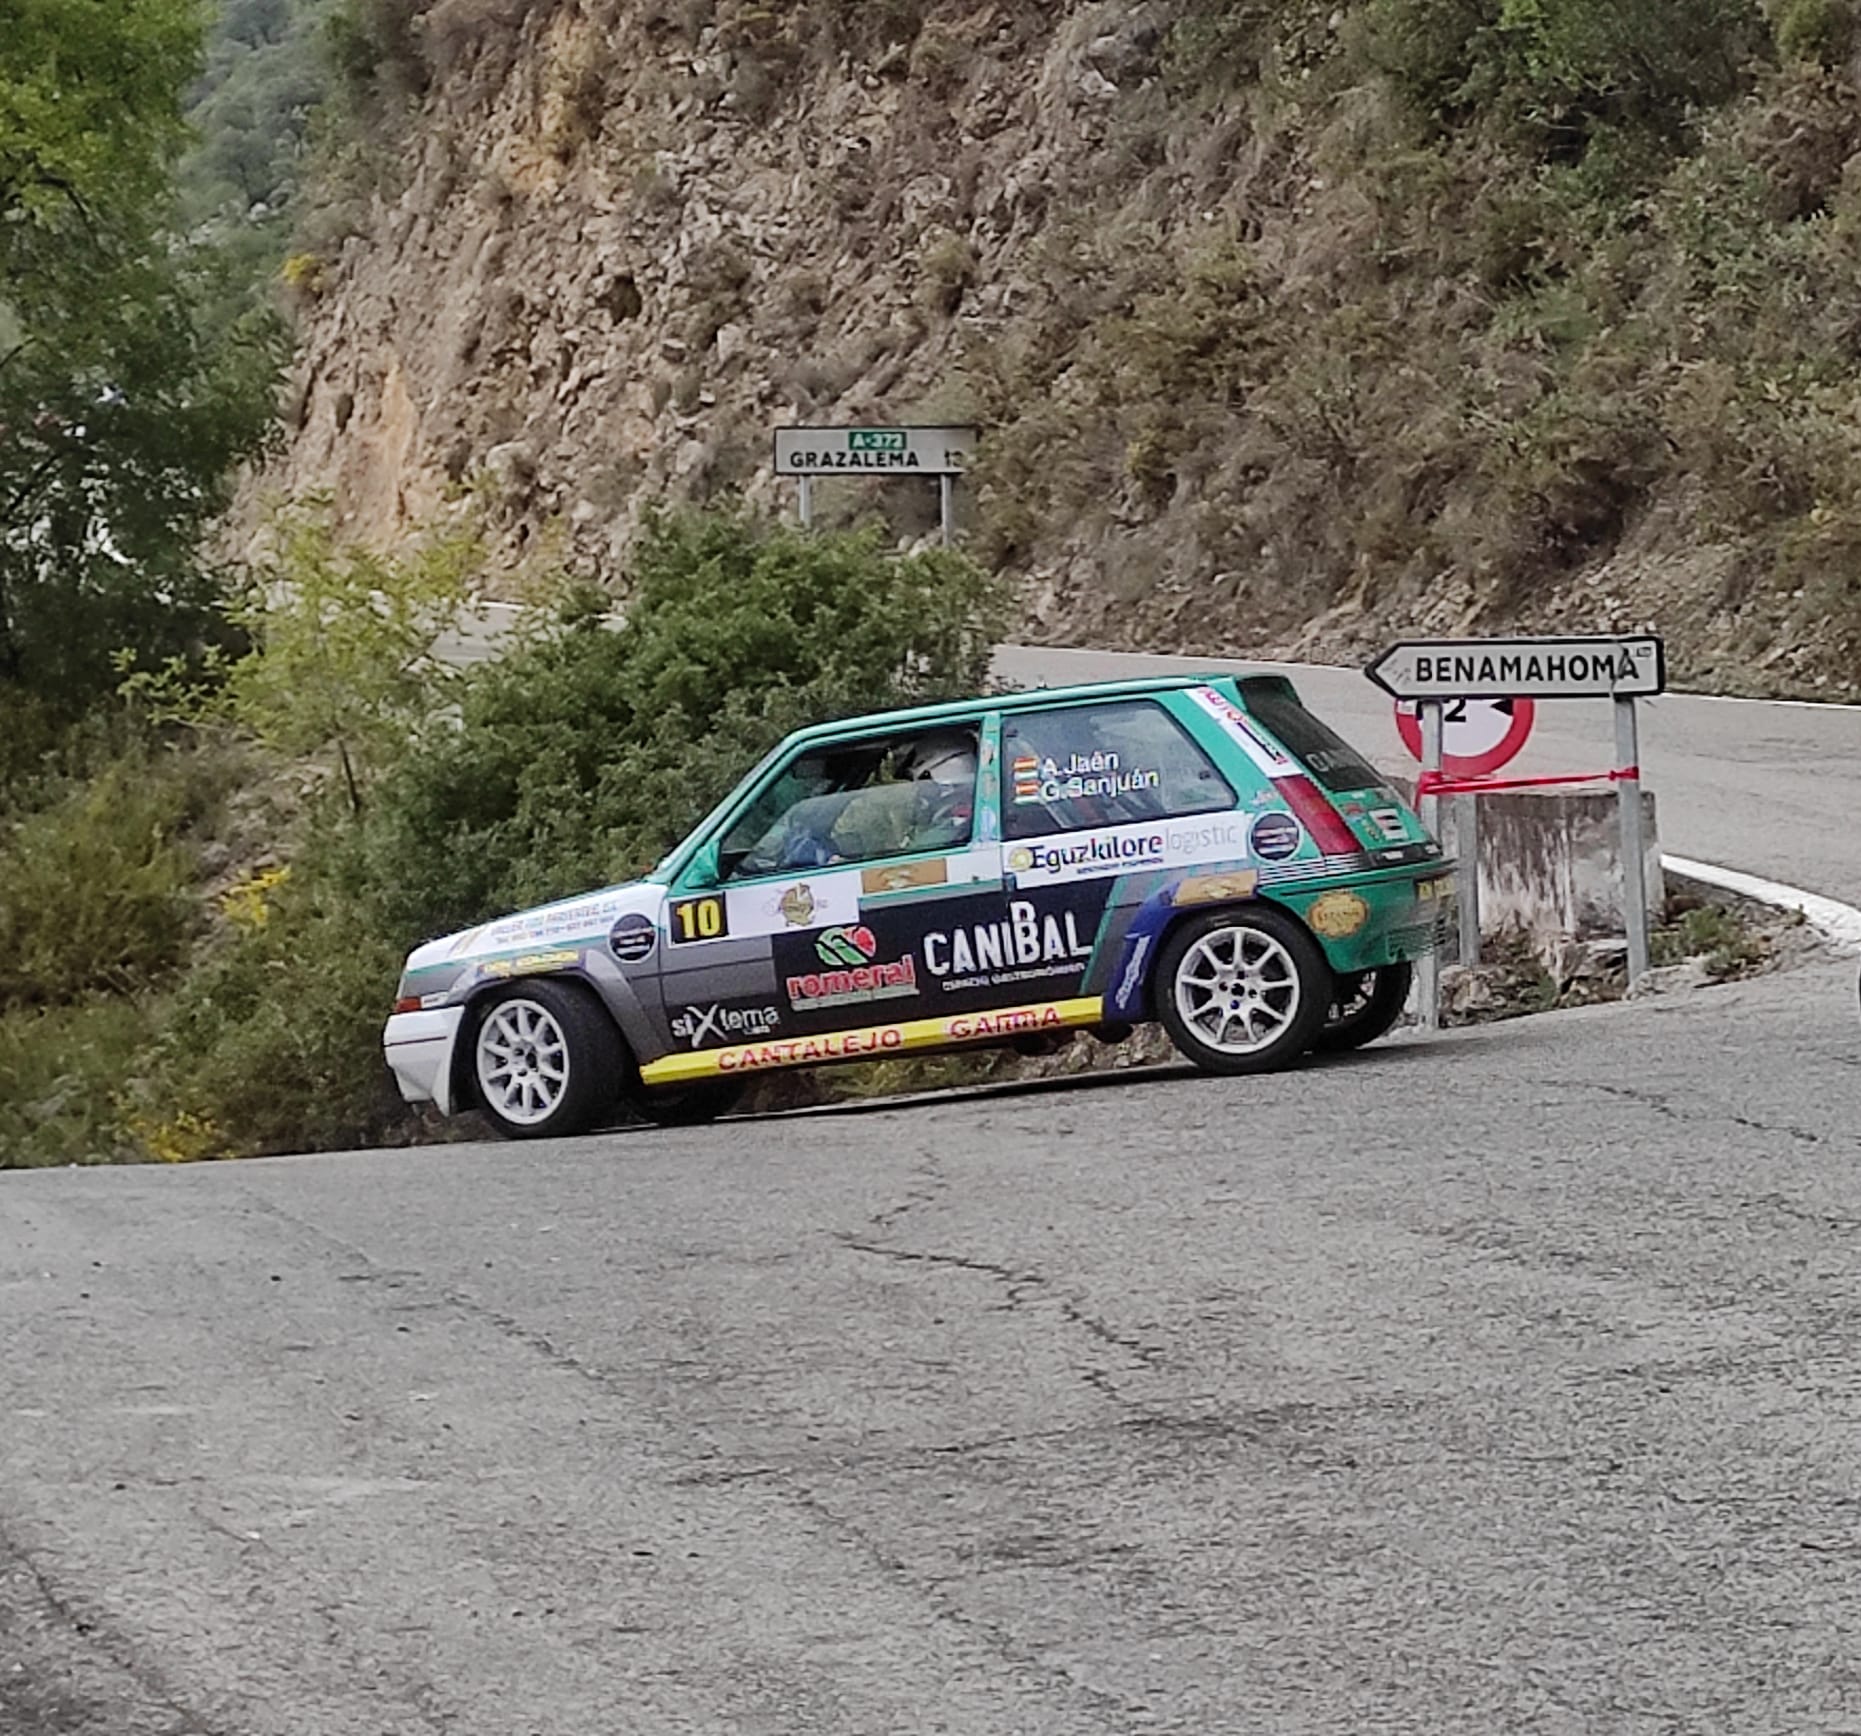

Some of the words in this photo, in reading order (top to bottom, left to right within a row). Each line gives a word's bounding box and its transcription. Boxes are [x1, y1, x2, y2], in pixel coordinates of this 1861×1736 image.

[790, 451, 919, 467] GRAZALEMA
[1416, 647, 1640, 682] BENAMAHOMA
[1029, 834, 1163, 873] Eguzkilore
[676, 899, 723, 939] 10
[923, 900, 1094, 976] CANIBAL
[786, 954, 917, 1000] romeral
[717, 1029, 902, 1071] CANTALEJO
[950, 1007, 1062, 1039] GAMMA
